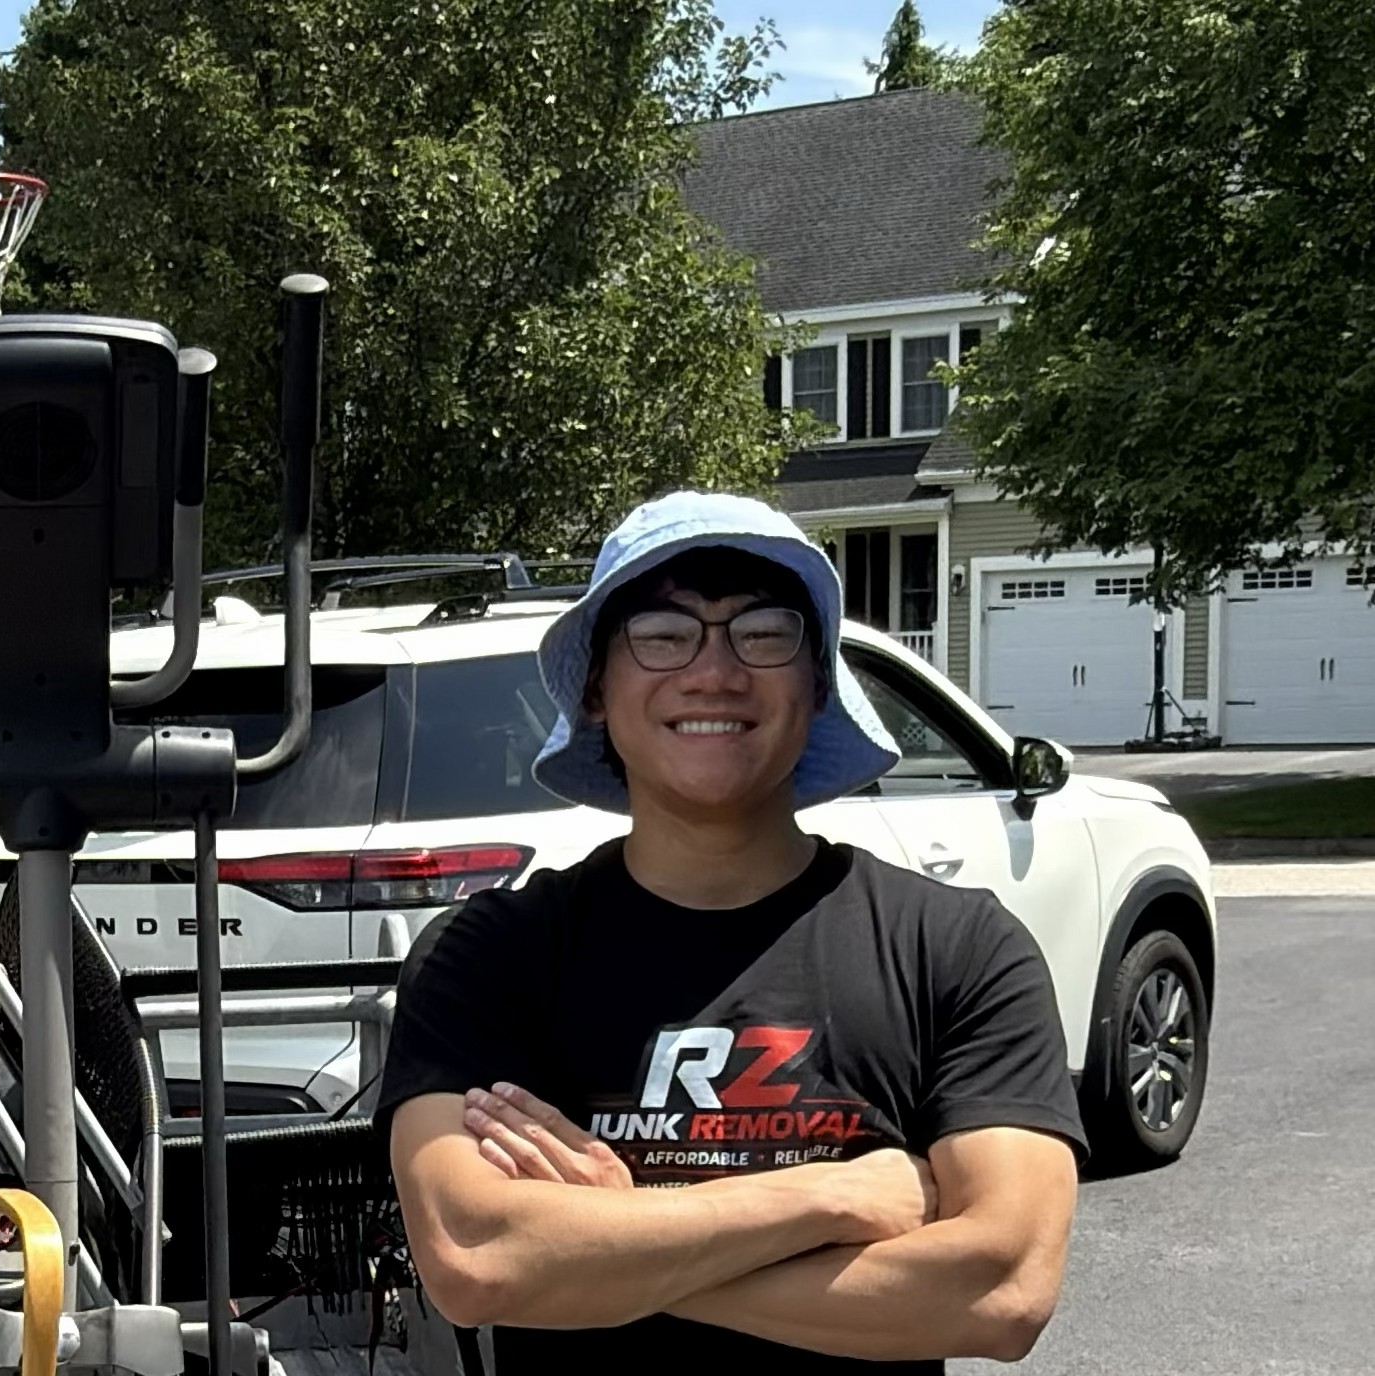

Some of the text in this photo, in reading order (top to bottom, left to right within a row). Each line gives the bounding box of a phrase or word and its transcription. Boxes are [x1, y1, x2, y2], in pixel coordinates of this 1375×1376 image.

[639, 1026, 814, 1109] RZ
[590, 1110, 867, 1142] JUNK REMOVAL
[644, 1151, 750, 1167] AFFORDABLE
